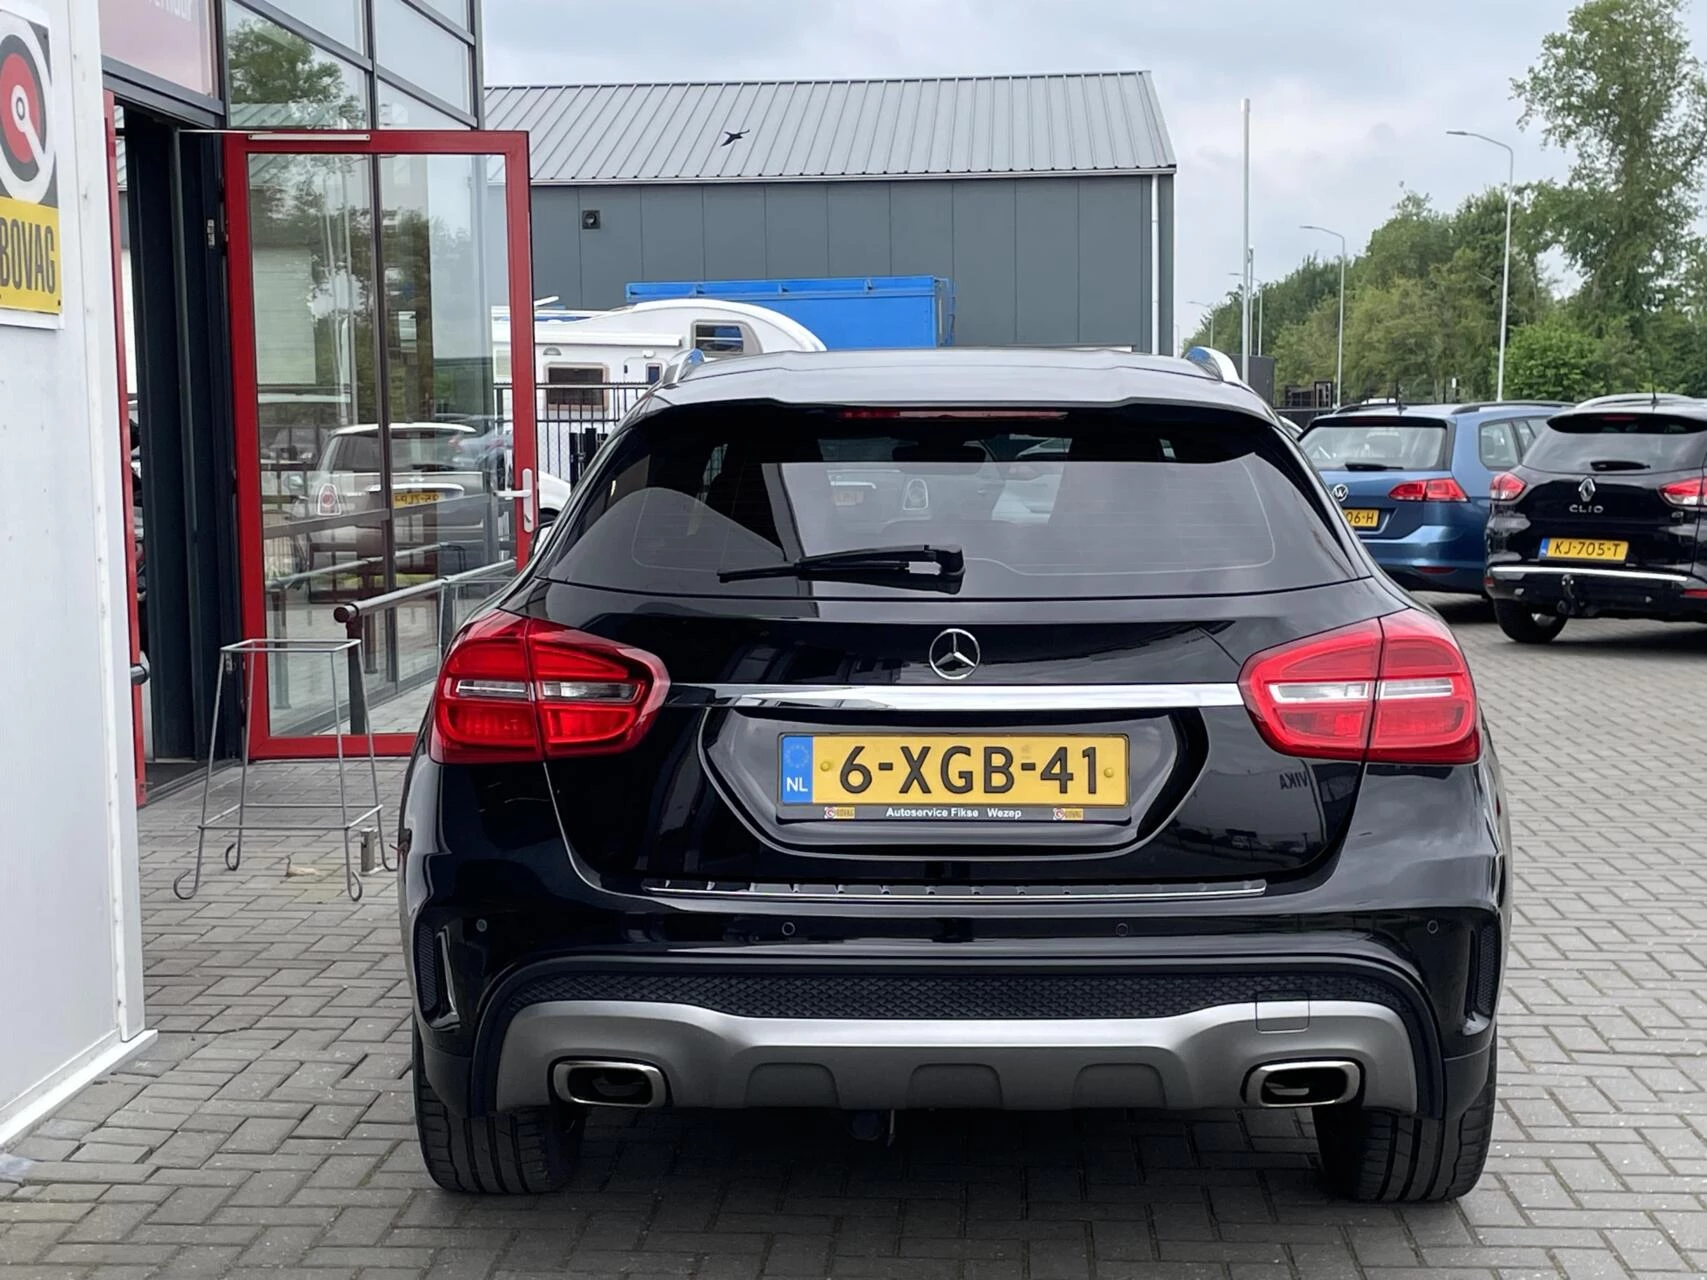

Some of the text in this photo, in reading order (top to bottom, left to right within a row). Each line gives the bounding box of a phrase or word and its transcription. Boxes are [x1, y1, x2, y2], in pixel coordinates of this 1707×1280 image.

[0, 217, 55, 294] BOVAG
[1569, 504, 1604, 513] CLIO
[1554, 541, 1621, 558] KJ-705-T
[839, 745, 1097, 795] 6-XGB-41
[786, 777, 809, 793] NL
[886, 807, 1022, 820] Autoservice Fikse Wezep
